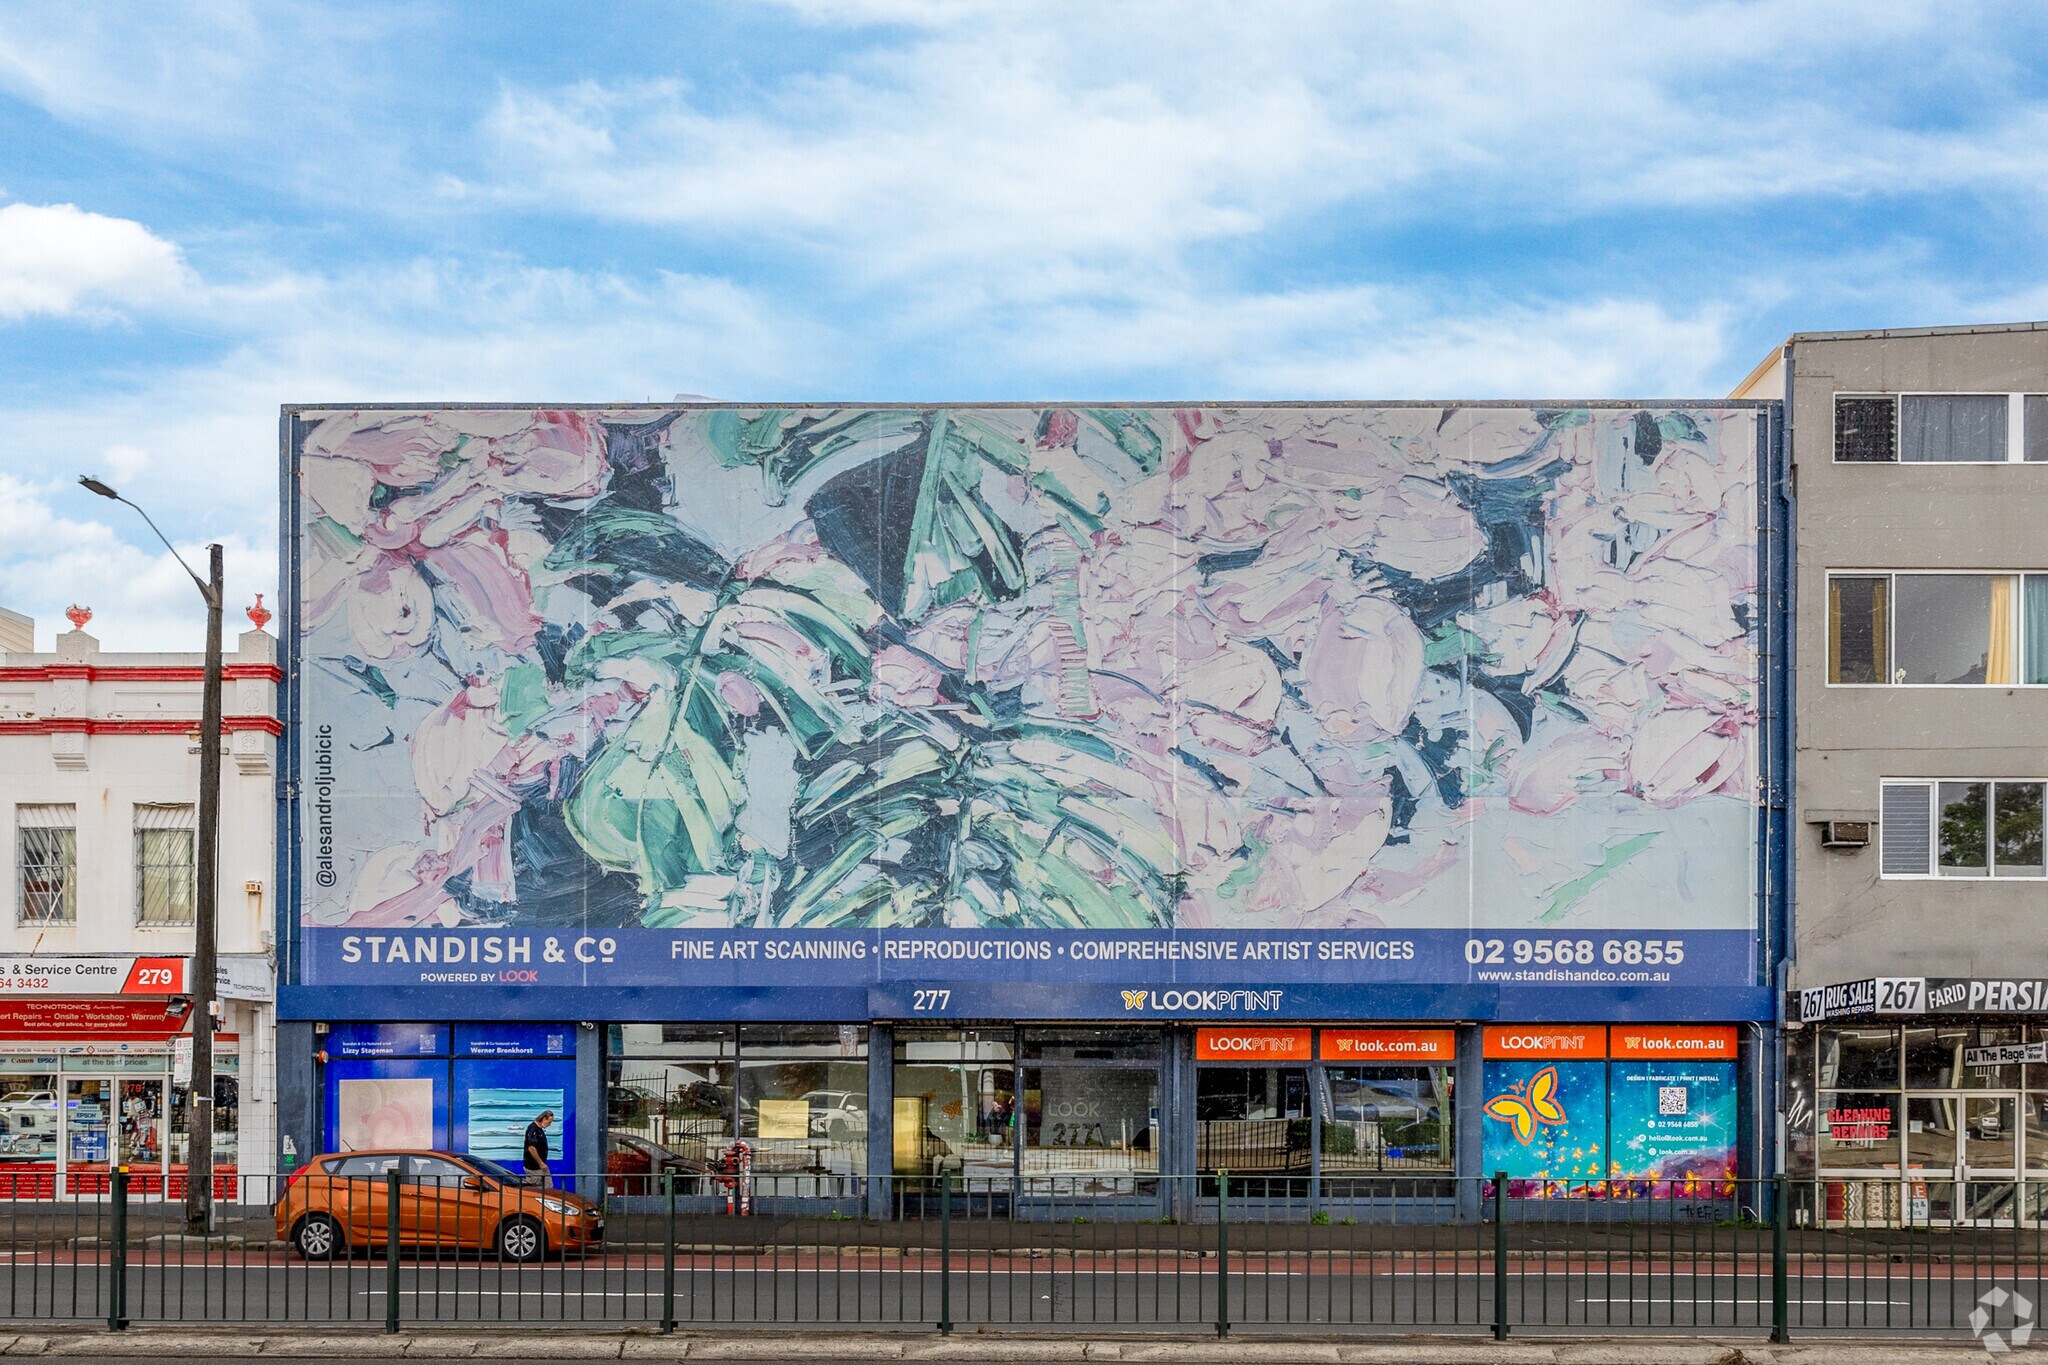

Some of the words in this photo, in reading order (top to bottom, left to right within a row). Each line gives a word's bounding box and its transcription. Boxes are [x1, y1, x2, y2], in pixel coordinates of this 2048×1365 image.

[315, 724, 337, 888] @alesandroljubicic
[342, 936, 531, 963] STANDISH
[543, 936, 566, 963] &
[671, 941, 714, 959] FINE
[719, 941, 759, 959] ART
[764, 941, 866, 960] SCANNING
[885, 941, 1052, 960] REPRODUCTIONS
[1070, 941, 1237, 960] COMPREHENSIVE
[1242, 941, 1312, 960] ARTIST
[1317, 941, 1415, 960] SERVICES
[1464, 939, 1505, 964] 02
[1513, 939, 1595, 964] 9568
[1602, 939, 1684, 965] 6855
[12, 964, 22, 975] &
[25, 964, 72, 975] Service
[75, 964, 118, 975] Centre
[138, 969, 173, 985] 279
[420, 972, 478, 982] POWERED
[481, 972, 496, 982] BY
[498, 970, 538, 982] LOOK
[1478, 970, 1670, 982] www.standishandco.com.au
[17, 978, 49, 988] 3432
[913, 990, 951, 1011] 277
[1151, 990, 1283, 1011] LOOKPRINT
[1826, 985, 1848, 1009] RUG
[1848, 980, 1875, 1005] SALE
[1880, 981, 1921, 1010] 267
[1928, 984, 1967, 1009] FARID
[1803, 990, 1823, 1018] 267
[1826, 1007, 1851, 1018] WASHING
[1851, 1004, 1875, 1014] REPAIRS
[13, 1013, 42, 1021] Repairs
[85, 1013, 125, 1021] Workshop
[131, 1013, 166, 1022] Warranty
[1210, 1037, 1295, 1051] LOOKPRINT
[1355, 1039, 1438, 1052] look.com.au
[1501, 1036, 1585, 1049] LOOKPRINT
[1642, 1037, 1724, 1050] look.com.au
[124, 1058, 148, 1067] prices
[1966, 1050, 1978, 1062] All
[1980, 1049, 1997, 1061] The
[2000, 1048, 2025, 1063] Rage
[1049, 1102, 1100, 1117] LOOK
[1826, 1107, 1891, 1122] CLEANING
[1832, 1125, 1889, 1139] REPAIRS
